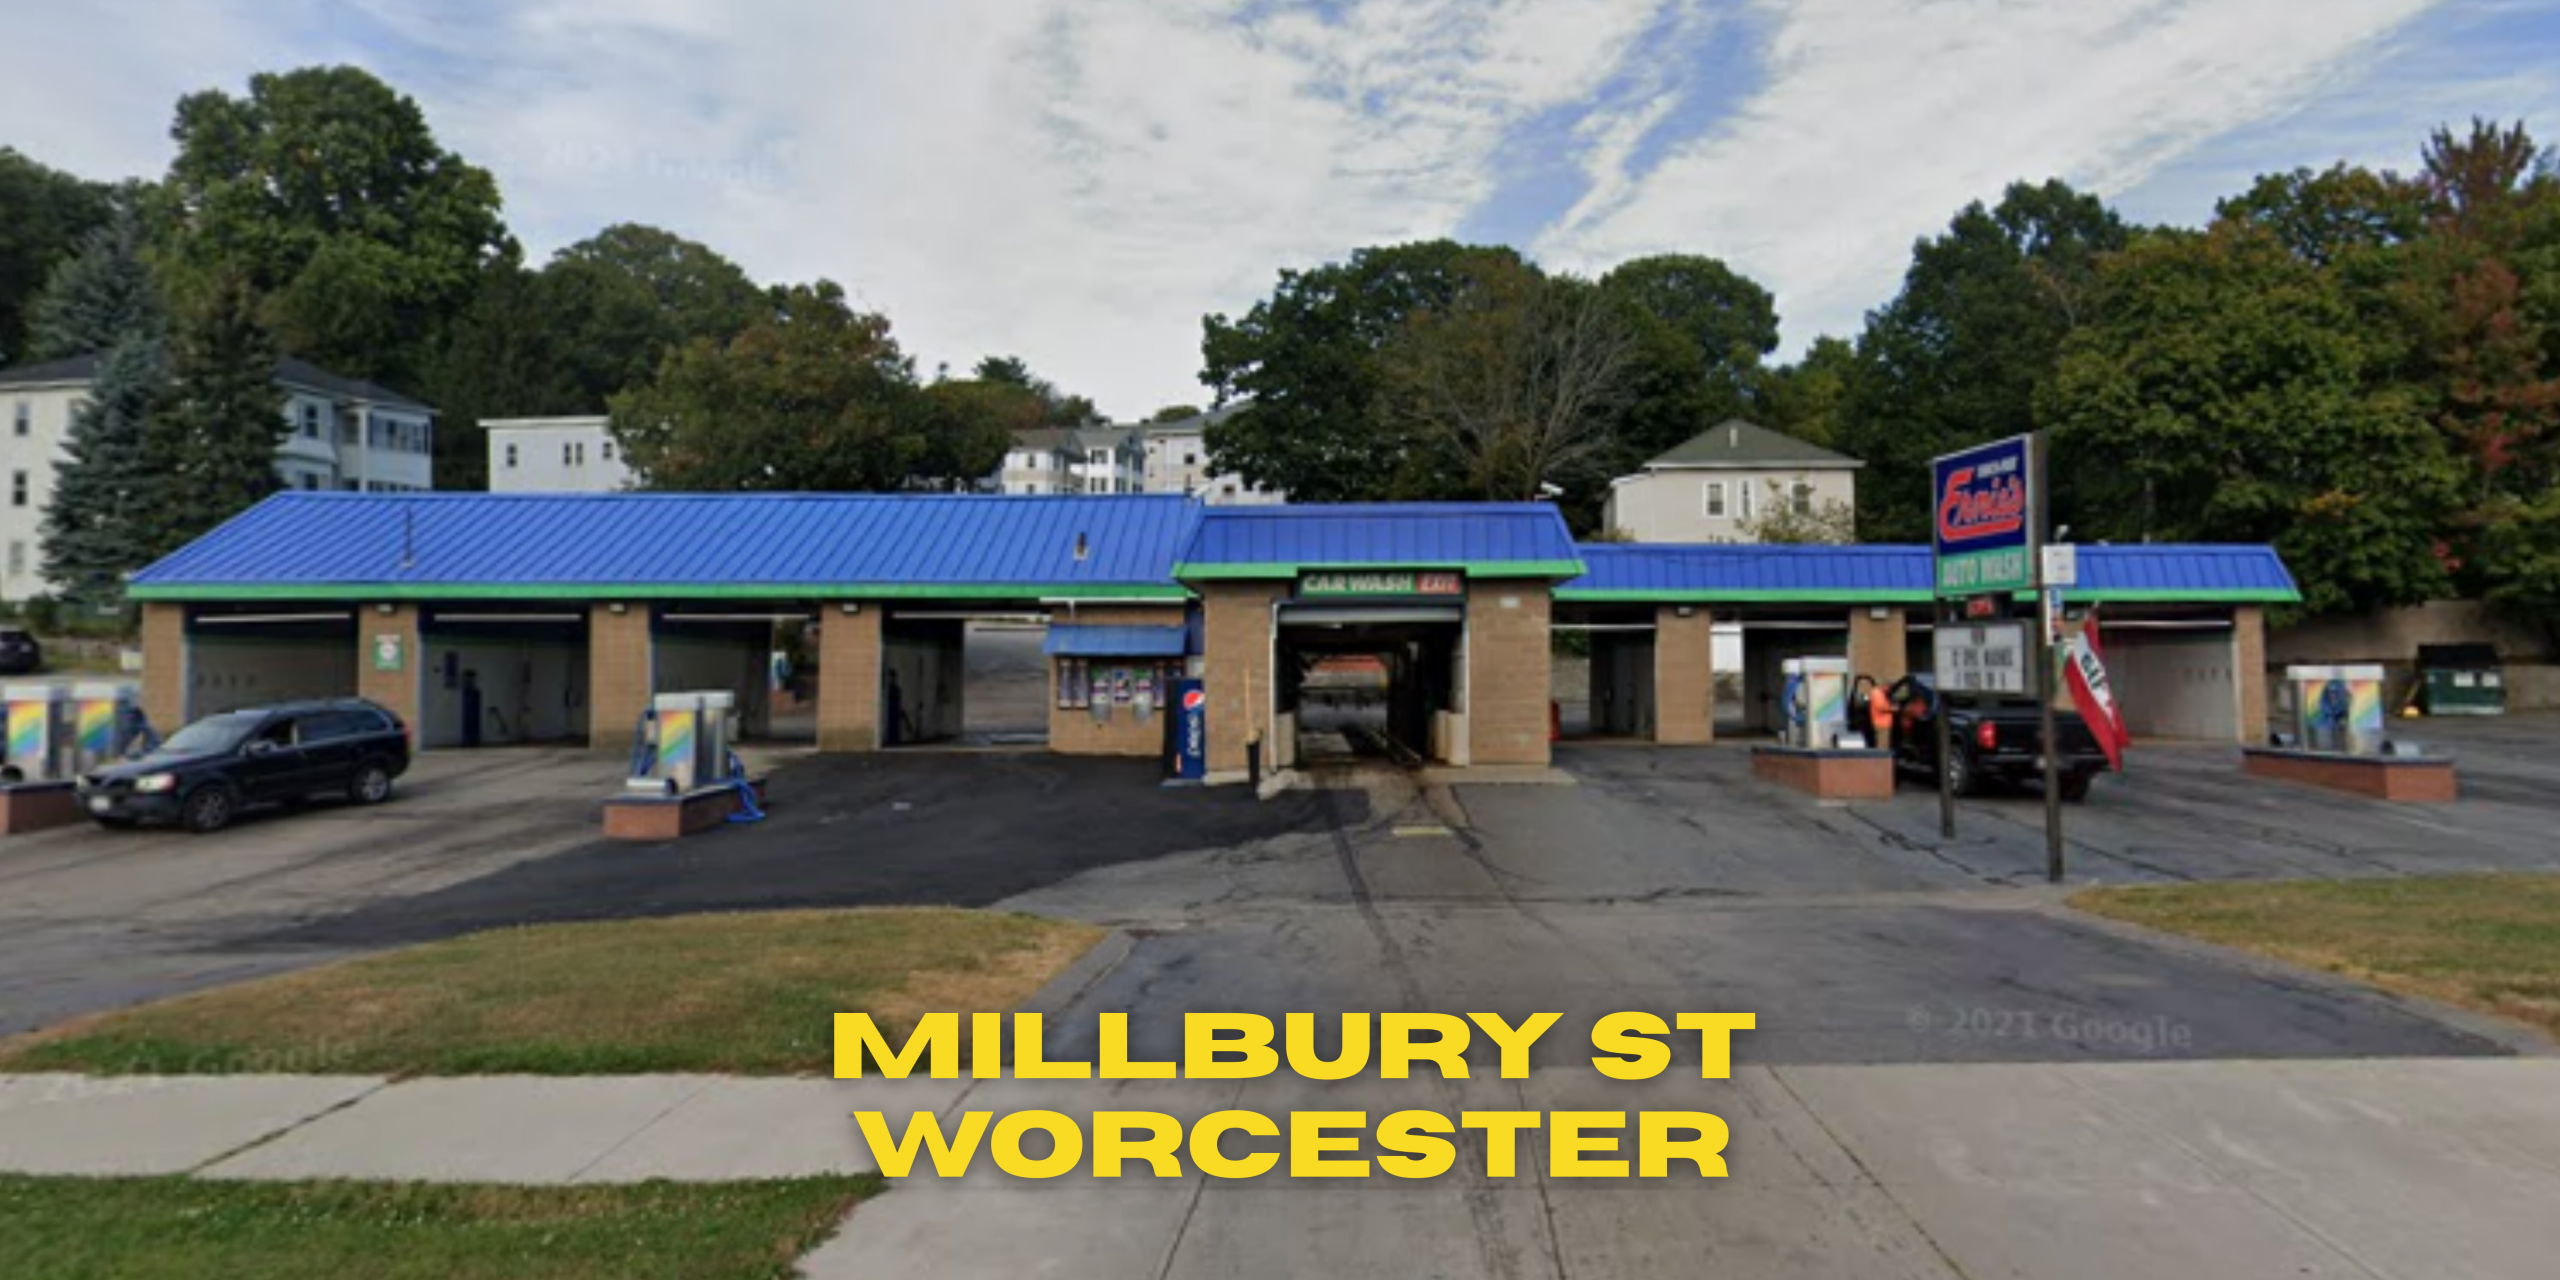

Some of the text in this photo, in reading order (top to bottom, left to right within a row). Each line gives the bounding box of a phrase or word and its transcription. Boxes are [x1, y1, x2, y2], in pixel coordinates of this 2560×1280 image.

[1302, 572, 1347, 592] CAR
[1350, 572, 1412, 592] WASH
[1943, 558, 1978, 587] AUTO
[1981, 552, 2023, 584] WASH
